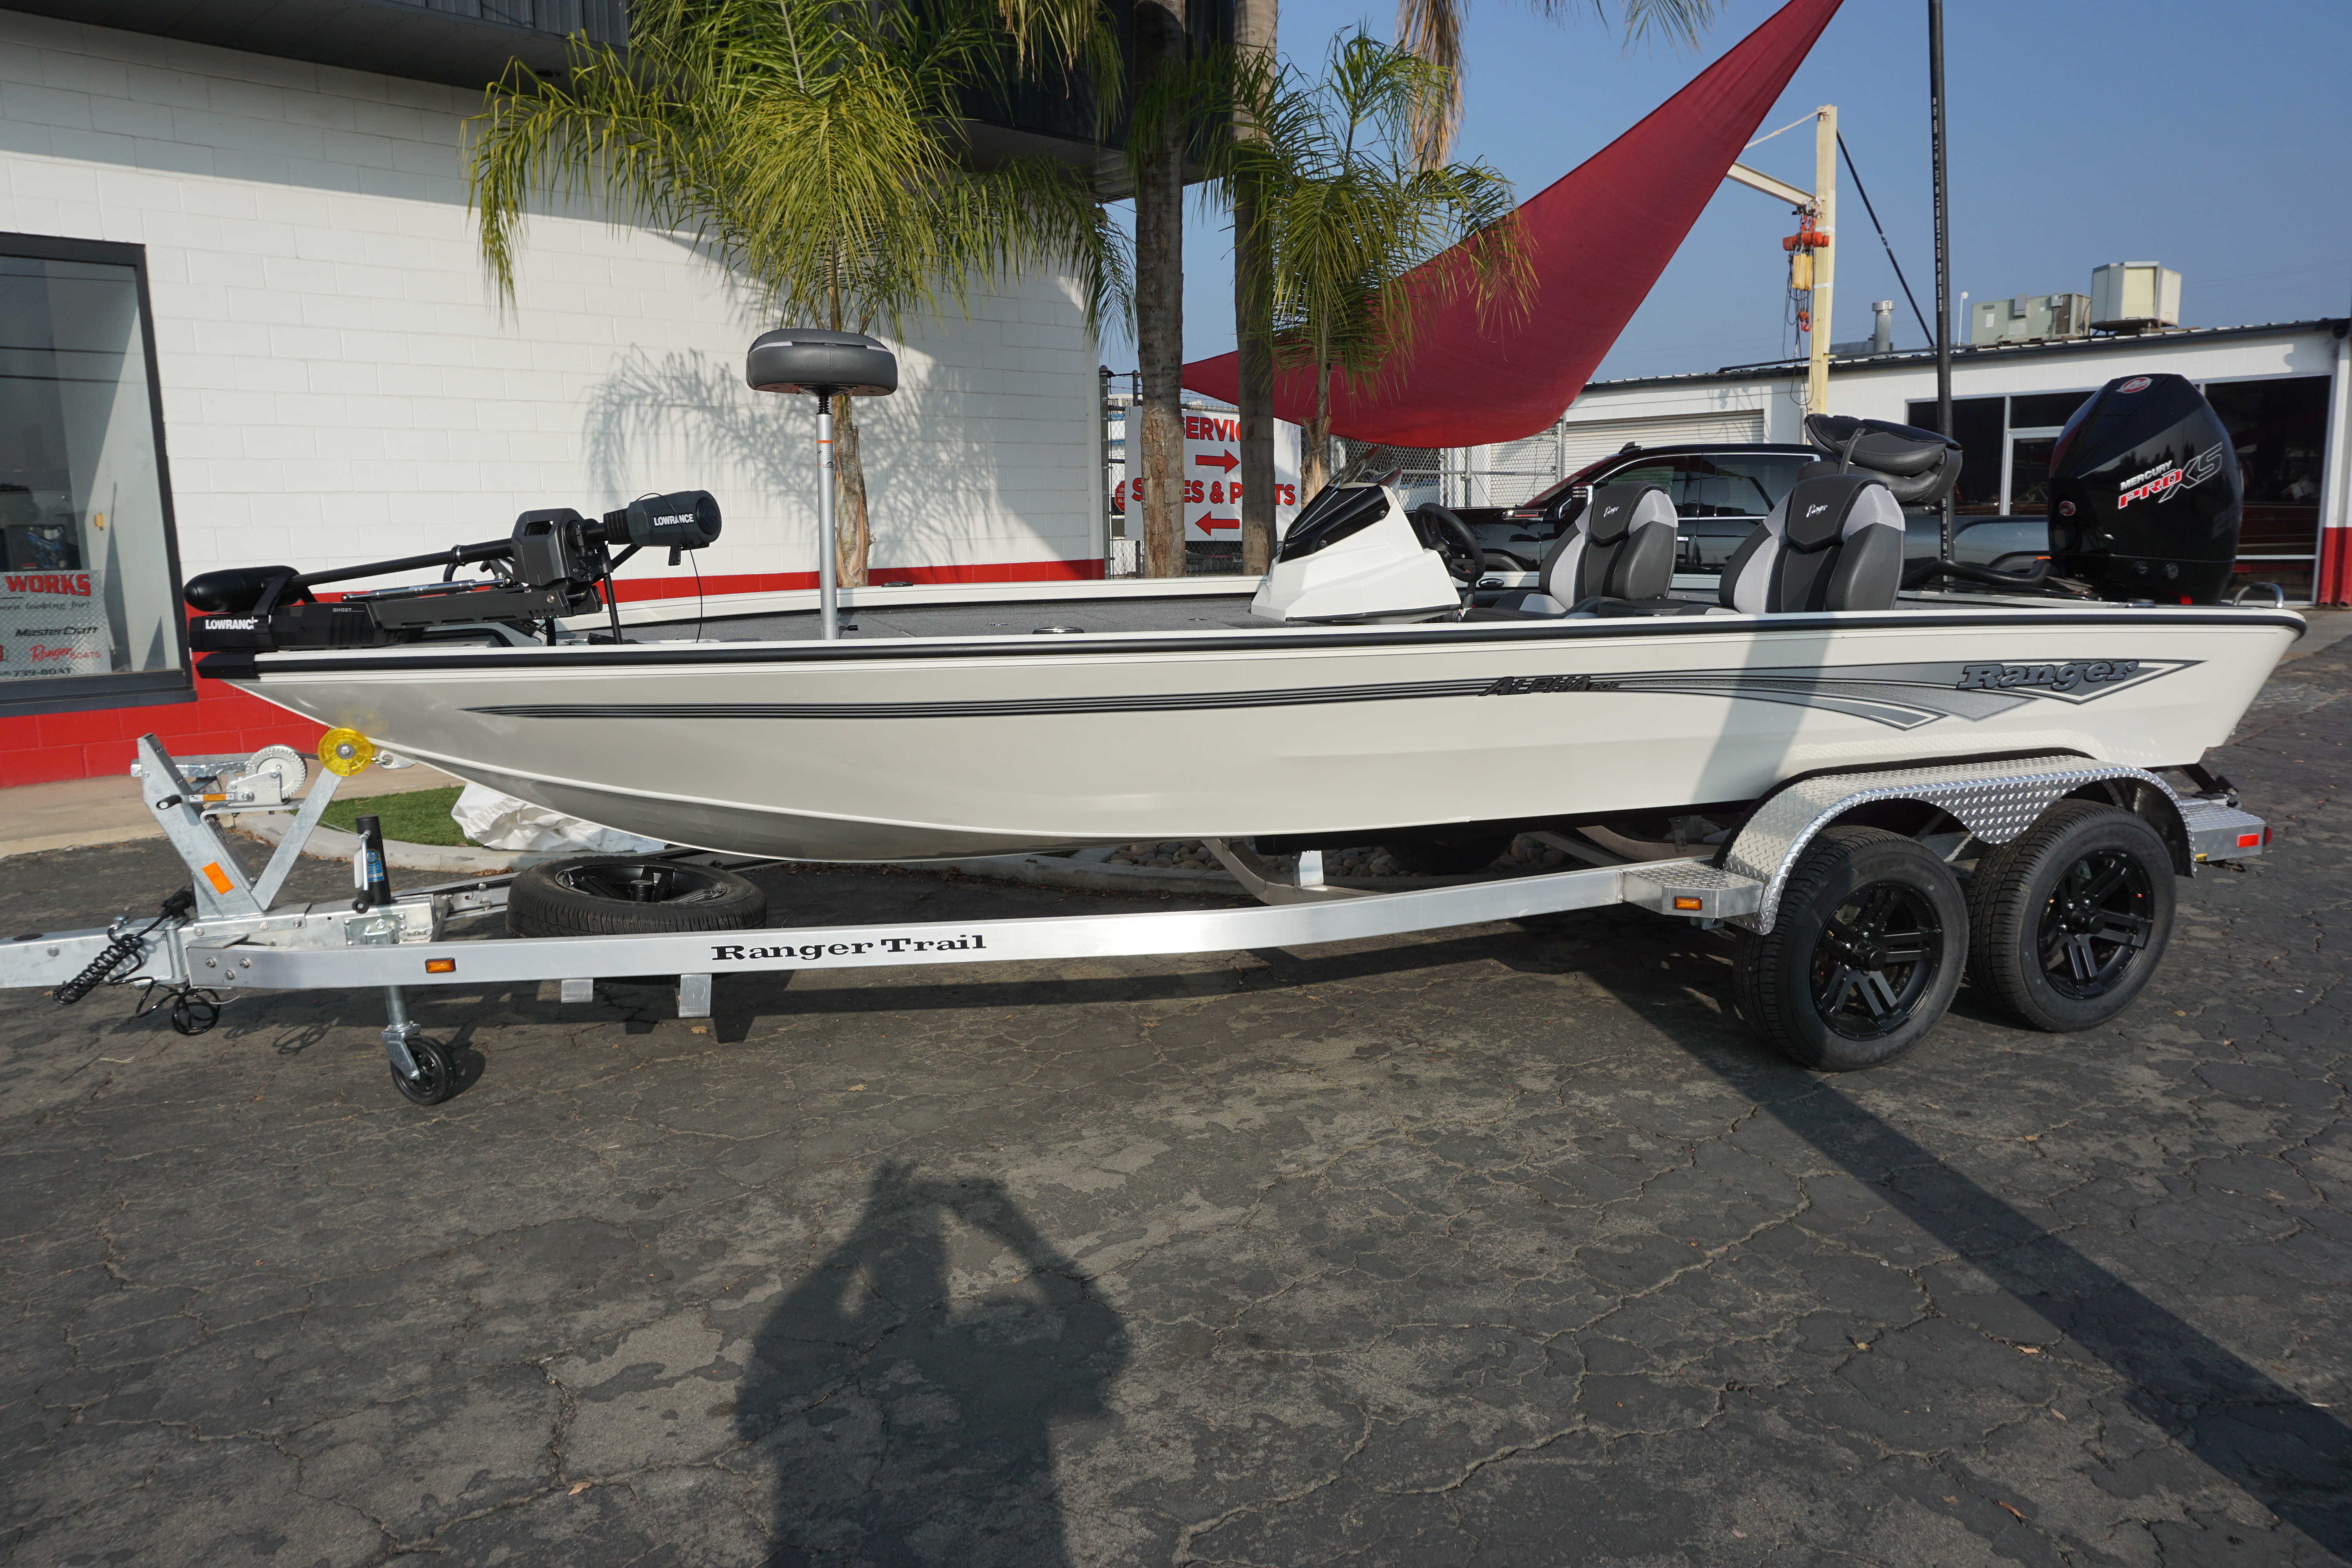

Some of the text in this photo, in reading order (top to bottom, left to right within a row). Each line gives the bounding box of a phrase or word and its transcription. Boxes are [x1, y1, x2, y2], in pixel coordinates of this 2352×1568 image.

[1181, 416, 1241, 442] ERVI
[2120, 459, 2173, 491] MERCURY
[1131, 477, 1296, 506] SES & PTS
[653, 514, 694, 526] LOWRANCE
[5, 574, 91, 597] WORKS
[15, 626, 98, 637] MasterCraft
[29, 645, 101, 663] Ranger BOATS
[1478, 676, 1621, 697] ALPHA 208
[1956, 660, 2140, 691] Ranger
[711, 935, 987, 961] Ranger Trail
